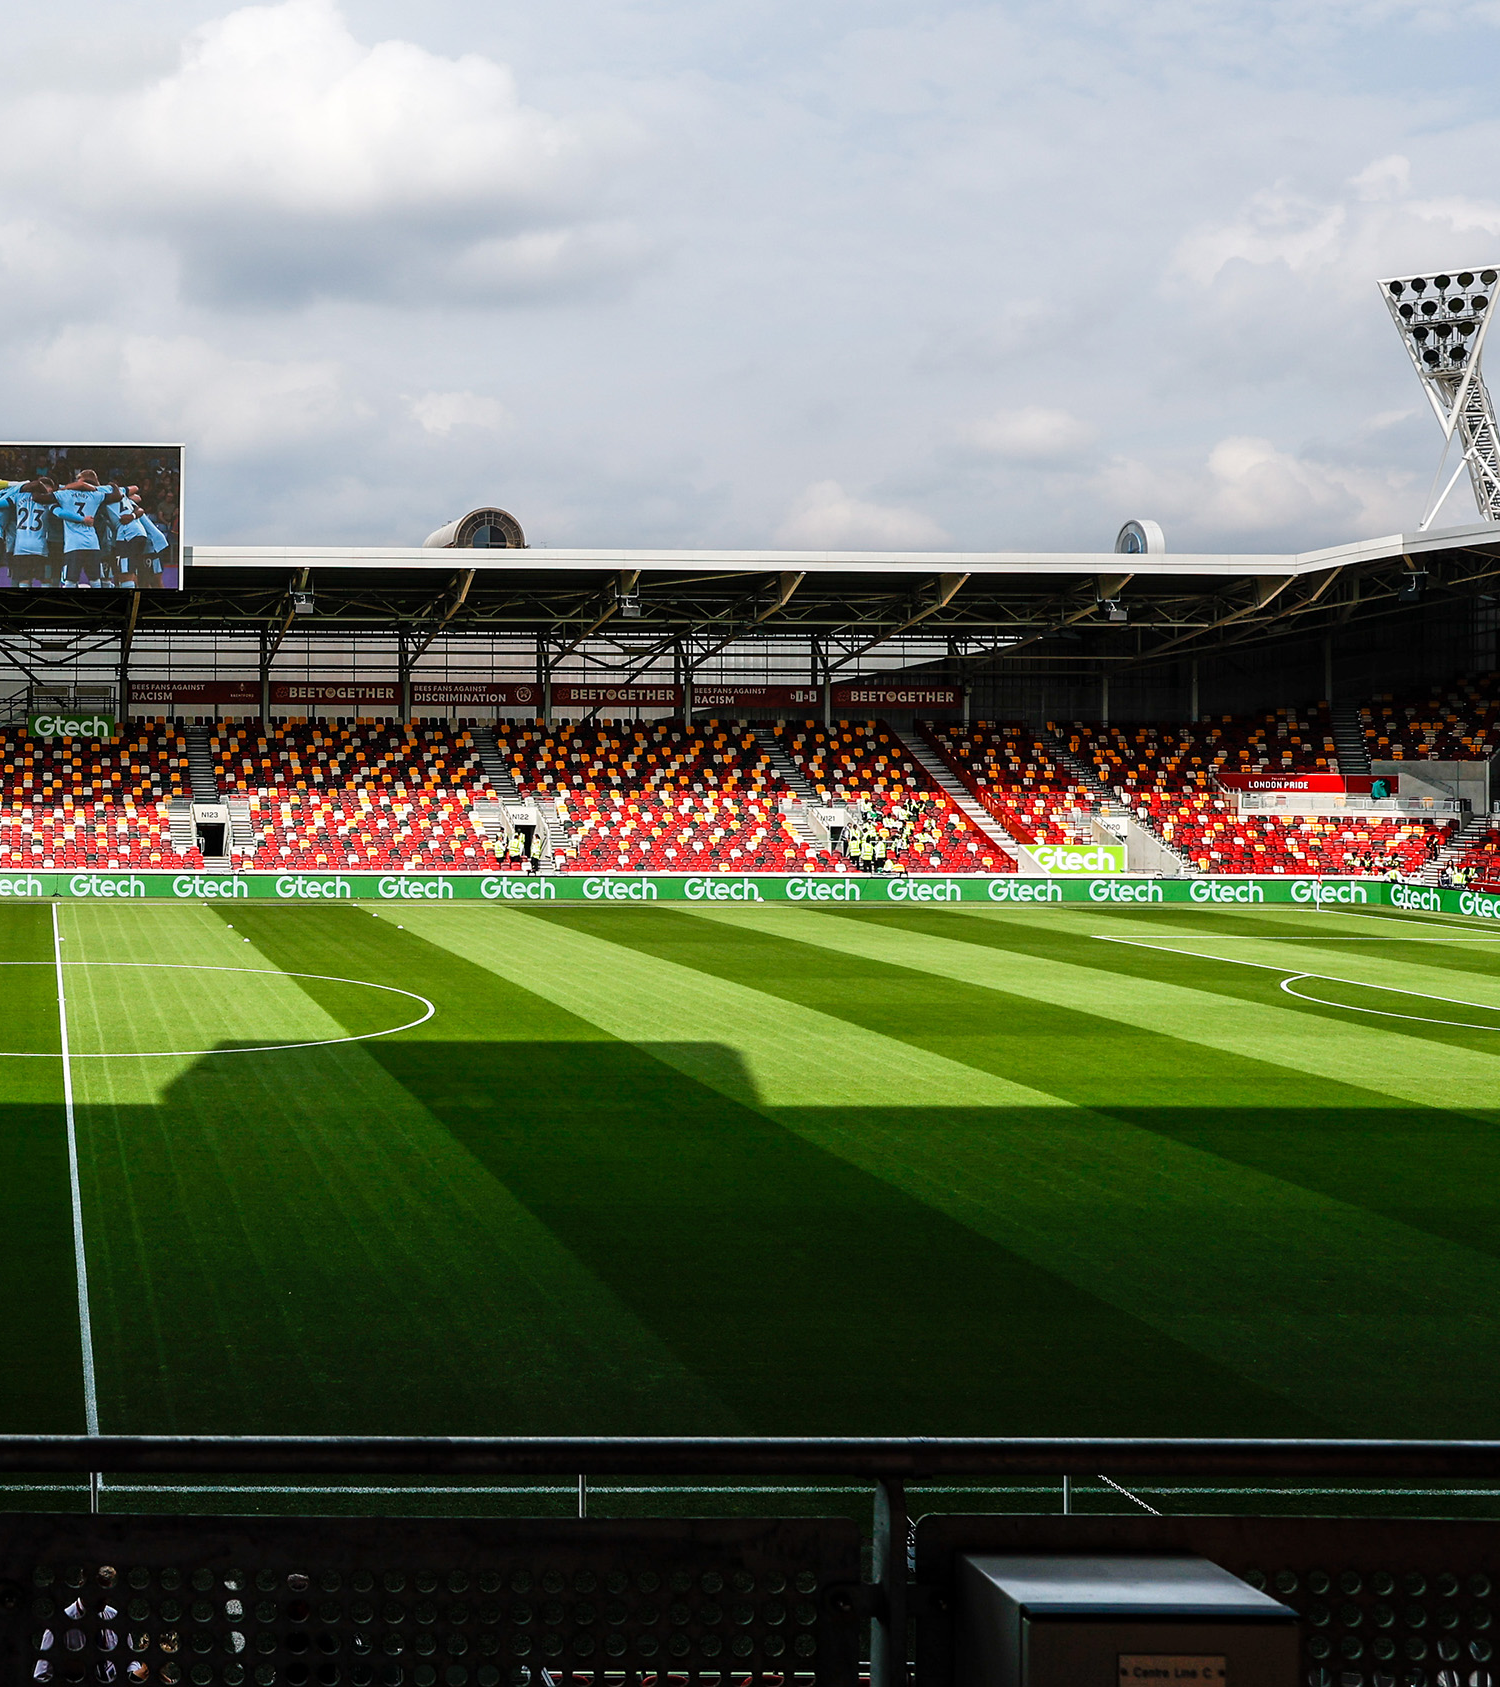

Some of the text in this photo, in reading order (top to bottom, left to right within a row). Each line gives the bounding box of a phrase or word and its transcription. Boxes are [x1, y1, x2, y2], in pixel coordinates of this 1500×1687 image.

[17, 507, 45, 531] 23
[131, 683, 206, 691] BEES FANS AGAINST
[414, 685, 487, 693] BEES FANS AGAINST
[131, 691, 173, 701] RACISM
[414, 693, 507, 703] DISCRIMINATION
[694, 695, 735, 704] RACISM
[34, 715, 109, 737] Gtech
[1248, 781, 1309, 789] LONDON PRIDE
[1033, 846, 1116, 872] Gtech
[70, 875, 145, 897] Gtech
[173, 875, 248, 898] Gtech
[276, 876, 350, 899] Gtech
[379, 876, 453, 899] Gtech
[481, 877, 555, 900] Gtech
[583, 877, 657, 900] Gtech
[685, 878, 759, 902] Gtech
[786, 878, 860, 901] Gtech
[887, 879, 961, 902] Gtech
[988, 879, 1062, 902] Gtech
[1089, 879, 1162, 903] Gtech
[1190, 879, 1263, 903] Gtech
[1291, 879, 1366, 904] Gtech
[1390, 884, 1440, 912] Gtech
[1459, 891, 1500, 919] Gtec
[1133, 1667, 1212, 1678] Centre Line C
